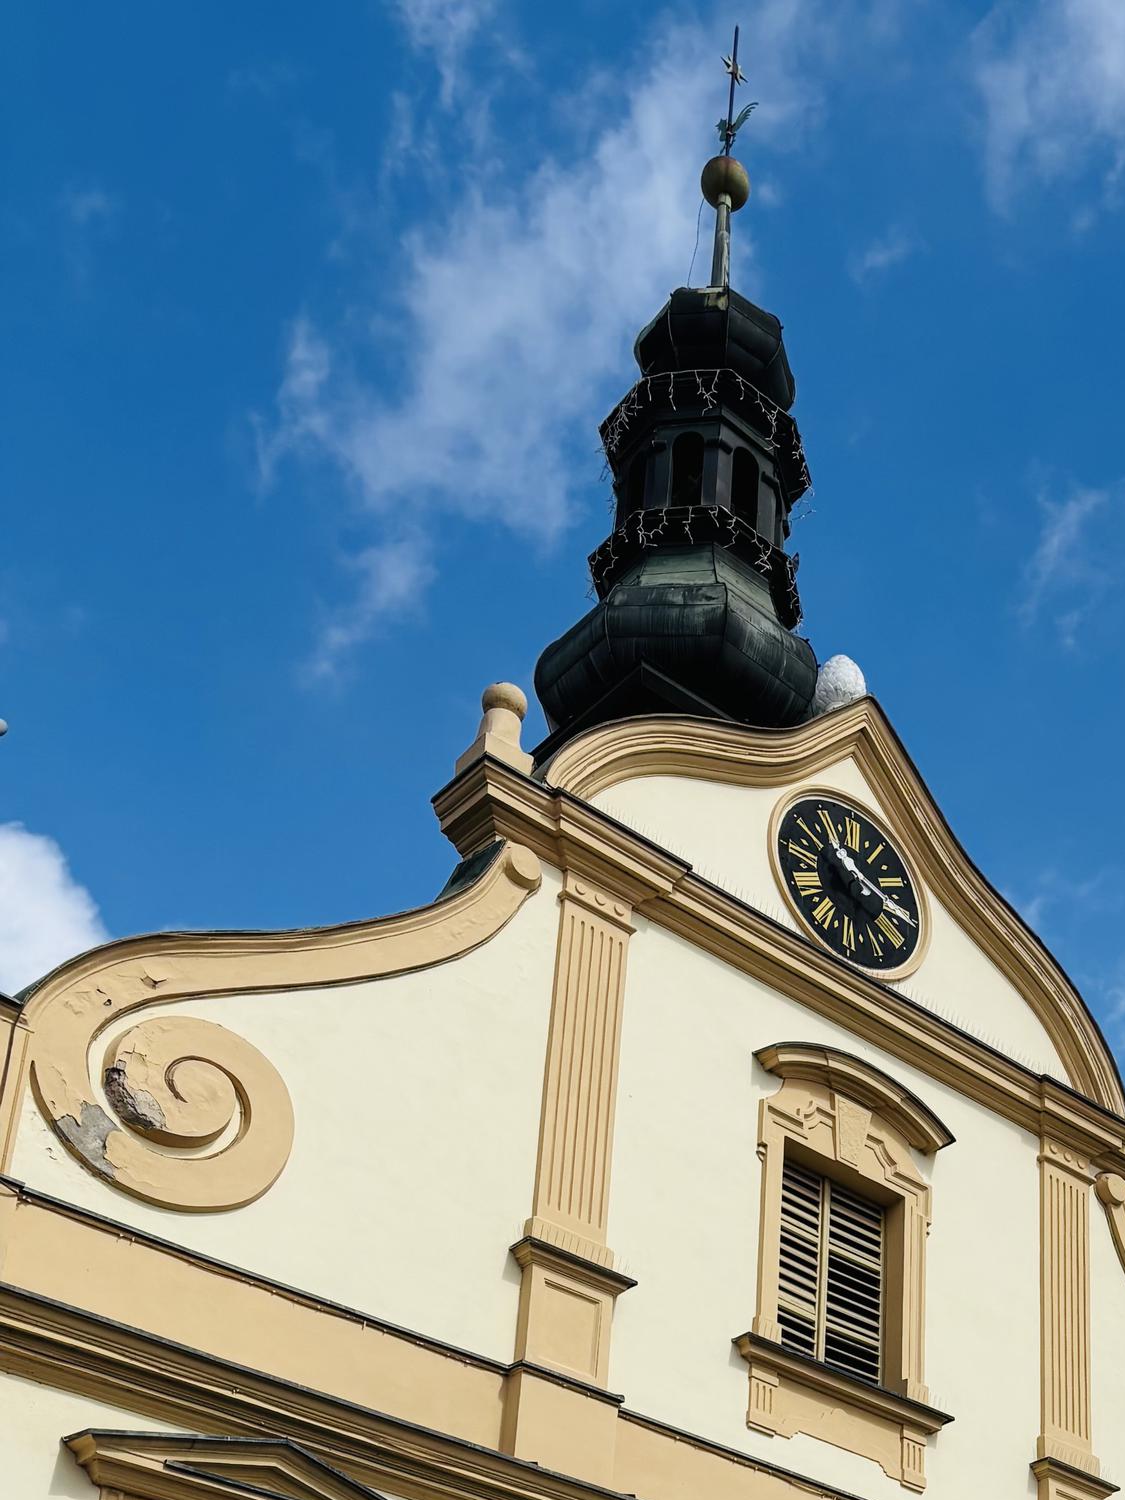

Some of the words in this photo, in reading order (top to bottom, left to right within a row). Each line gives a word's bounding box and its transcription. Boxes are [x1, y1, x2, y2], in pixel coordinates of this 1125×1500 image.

[797, 817, 823, 850] X
[844, 817, 860, 853] XII
[788, 840, 817, 868] IX
[867, 844, 884, 864] I
[793, 872, 822, 896] VIII
[878, 877, 904, 887] II
[812, 896, 835, 930] VII
[843, 915, 855, 951] VI
[867, 923, 883, 956] V
